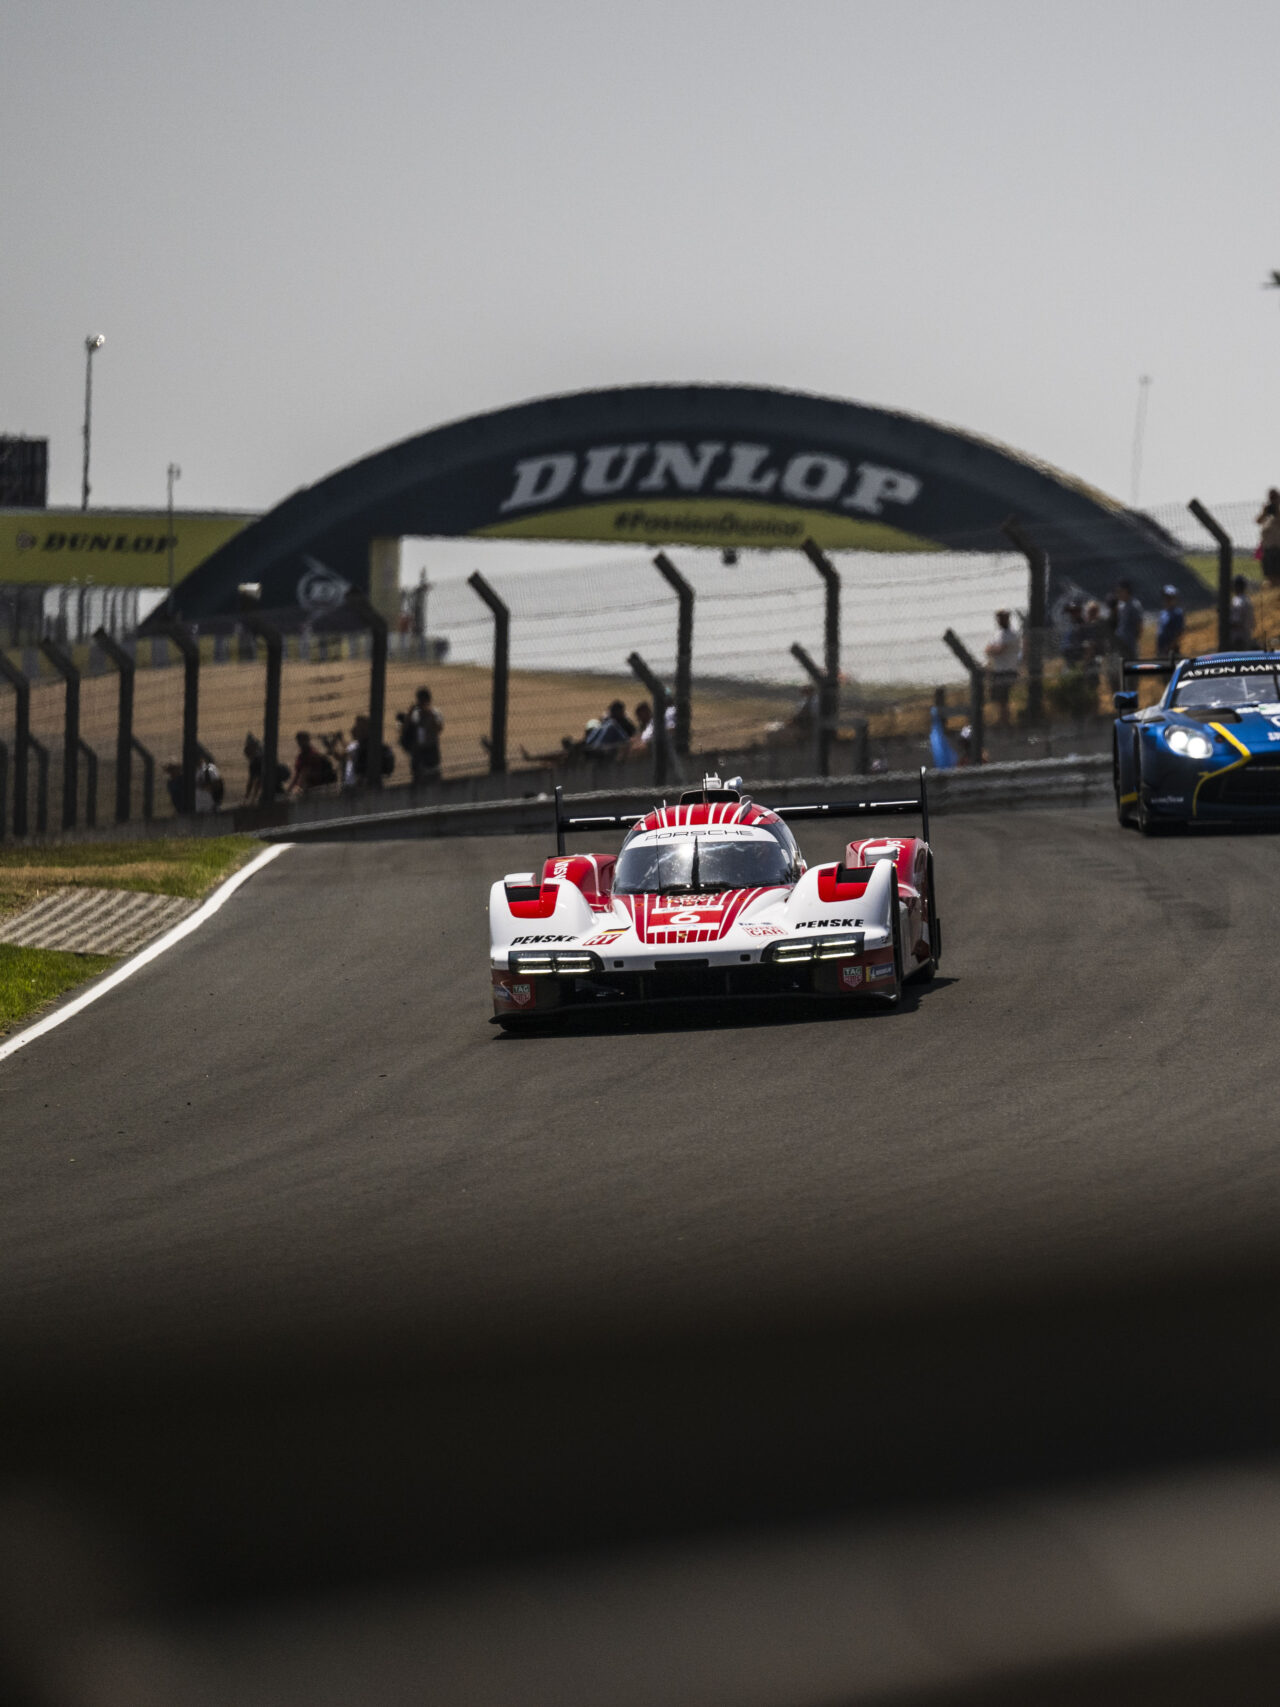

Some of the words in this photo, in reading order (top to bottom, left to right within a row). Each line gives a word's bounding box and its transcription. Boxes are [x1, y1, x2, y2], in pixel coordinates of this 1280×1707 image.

[500, 441, 923, 514] DUNLOP
[43, 532, 178, 553] DUNLOP
[1182, 665, 1236, 678] ASTON
[645, 830, 754, 841] PORSCHE
[669, 911, 700, 924] 6
[795, 919, 864, 930] PENSKE
[510, 935, 579, 946] PENSKE
[582, 934, 623, 946] HY
[844, 967, 861, 976] TAG
[514, 985, 529, 993] TAG
